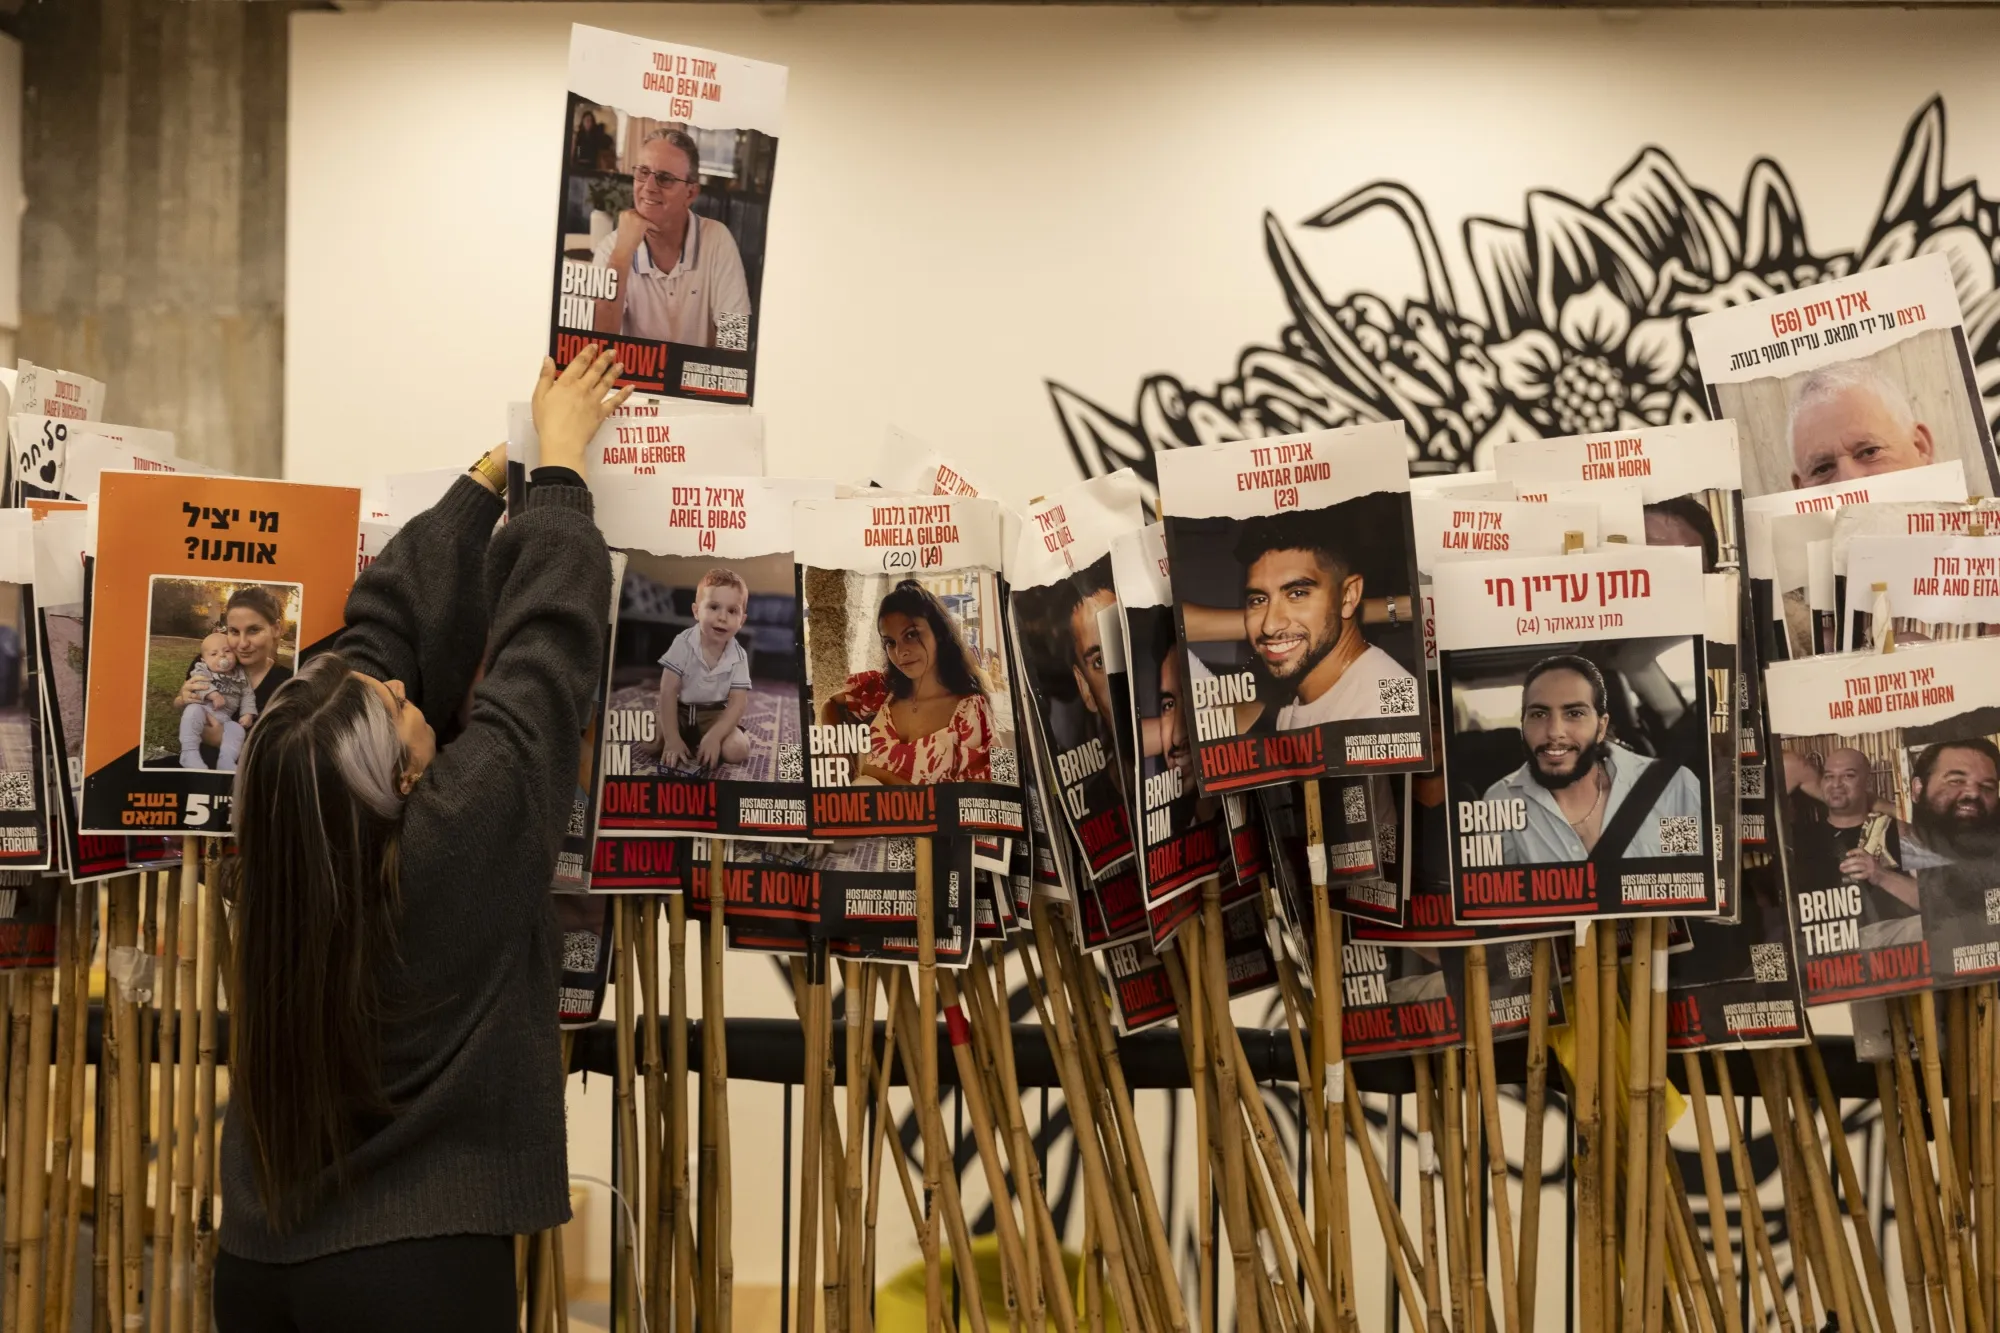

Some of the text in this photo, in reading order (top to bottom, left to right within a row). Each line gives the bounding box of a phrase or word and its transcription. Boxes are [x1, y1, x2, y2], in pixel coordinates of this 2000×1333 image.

[652, 52, 717, 80] אוהד בן עמי
[643, 72, 721, 102] OHAD BEN AMI
[670, 96, 693, 120] (55)
[561, 261, 618, 301] BRING
[558, 295, 596, 332] HIM
[1771, 290, 1871, 338] אילן וייס (56)
[1878, 312, 1895, 331] על
[1897, 304, 1926, 326] נרצח
[1859, 317, 1876, 335] ידי
[1761, 341, 1790, 363] חטוף
[1791, 332, 1820, 356] עדיין
[681, 370, 747, 393] FAMILIES FORUM
[616, 426, 670, 444] אגם ברגר
[603, 445, 686, 464] AGAM BERGER
[1250, 442, 1314, 468] אביתר דוד
[1586, 438, 1643, 463] איתן הורן
[1237, 462, 1331, 491] EVYATAR DAVID
[1582, 458, 1651, 482] EITAN HORN
[672, 486, 744, 508] אריאל ביבס
[1273, 488, 1300, 510] (23)
[182, 502, 279, 533] מי יציל
[669, 509, 747, 530] ARIEL BIBAS
[872, 505, 950, 525] דניאלה גלבוע
[1453, 511, 1503, 531] אילן וייס
[1907, 512, 1935, 535] הורן
[698, 530, 716, 553] (4)
[864, 525, 959, 547] DANIELA GILBOA
[1043, 533, 1060, 553] OZ
[1442, 531, 1510, 551] ILAN WEISS
[185, 536, 278, 565] אותנו?
[883, 550, 917, 570] (20)
[1934, 557, 1995, 577] ויאיר הורן
[1485, 568, 1651, 612] מתן עדיין חי
[1913, 577, 2000, 597] IAIR AND EITA
[1516, 613, 1624, 636] מתן צנגאוקר (24)
[1192, 672, 1257, 709] BRING
[1844, 667, 1934, 698] יאיר ואיתן הורן
[1829, 685, 1955, 720] IAIR AND EITAN HORN
[606, 710, 656, 742] RING
[1195, 707, 1237, 742] HIM
[808, 723, 871, 755] BRING
[1344, 732, 1421, 746] HOSTAGES AND MISSING
[605, 743, 632, 776] IM
[1056, 737, 1107, 787] BRING
[1200, 727, 1324, 779] HOME NOW!
[1346, 742, 1422, 762] FAMILIES FORUM
[811, 757, 851, 788] HER
[127, 793, 178, 808] בשבי
[601, 781, 717, 817] OME NOW!
[1144, 767, 1183, 811] BRING
[183, 793, 211, 826] 5
[739, 797, 788, 811] HOSTAGES AND
[812, 787, 937, 823] HOME NOW!
[958, 797, 1022, 813] HOSTAGES AND MISSING
[1066, 783, 1090, 820] OZ
[121, 810, 177, 826] חמאס
[739, 808, 783, 826] FAMILIES
[960, 808, 1023, 828] FAMILIES FORUM
[1146, 806, 1172, 846] HIM
[1458, 798, 1527, 834] BRING
[6, 827, 37, 838] MISSING
[1078, 809, 1120, 857] HOME
[3, 838, 38, 853] FORUM
[1461, 834, 1504, 867] HIM
[556, 861, 583, 879] ORUM
[1149, 840, 1183, 884] HOME
[1462, 862, 1596, 905] HOME NOW!
[1621, 872, 1704, 885] HOSTAGES AND MISSING
[761, 871, 821, 911] NOW!
[845, 888, 917, 901] HOSTAGES AND MISS
[1621, 885, 1667, 902] FAMILIES
[1669, 883, 1705, 899] FORUM
[845, 900, 892, 917] FAMILIES
[1798, 885, 1862, 924] BRING
[1801, 919, 1860, 956] THEM
[1109, 944, 1141, 979] HER
[1342, 944, 1387, 973] RING
[1952, 942, 1999, 958] HOSTAGES AND
[1806, 940, 1931, 991] HOME NOW!
[1954, 952, 1996, 973] FAMILIES
[565, 987, 595, 1001] MISSING
[1510, 995, 1524, 1006] AND
[559, 998, 593, 1015] FORUM
[1397, 995, 1459, 1036] NOW!
[1491, 1003, 1522, 1026] MILIES
[1723, 1000, 1795, 1016] HOSTAGES AND MISSING
[1725, 1010, 1797, 1032] FAMILIES FORUM
